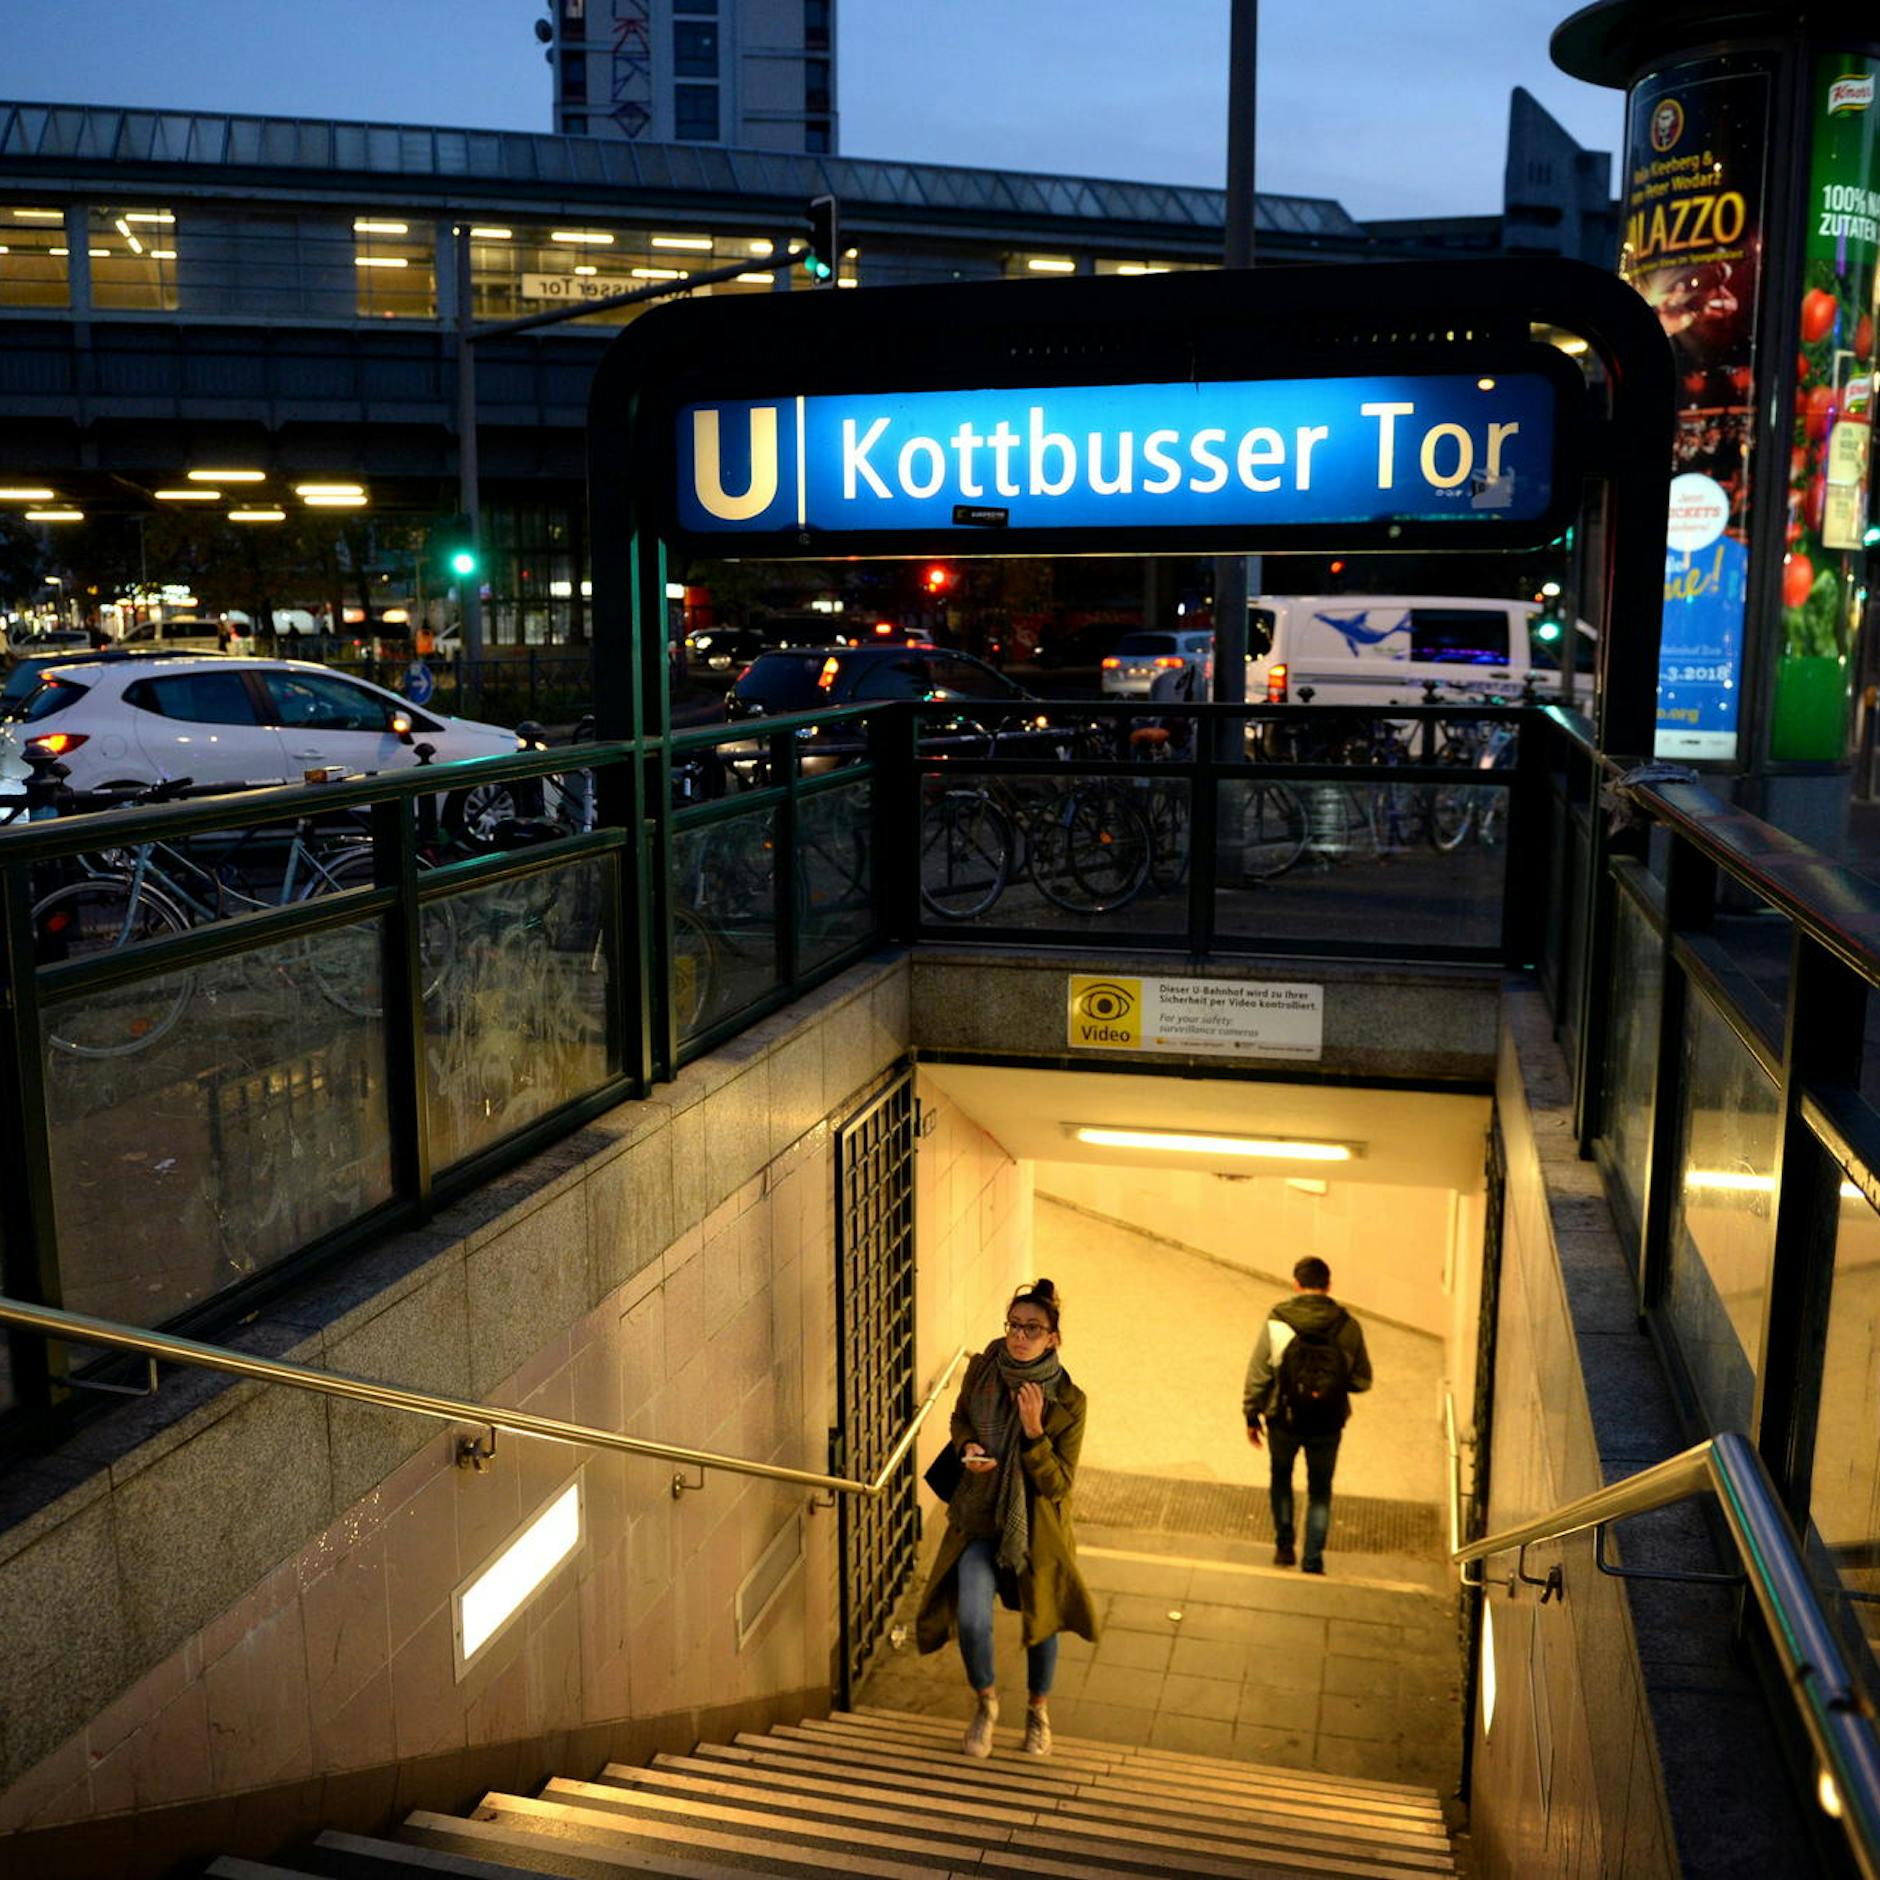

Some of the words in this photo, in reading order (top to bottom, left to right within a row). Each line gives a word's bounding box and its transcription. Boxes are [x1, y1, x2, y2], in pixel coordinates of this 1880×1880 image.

[1822, 184, 1866, 215] 100%
[694, 407, 778, 521] U
[842, 406, 1329, 500] Kottbusser
[1360, 402, 1518, 489] Tor
[1669, 505, 1722, 518] ICKETS
[1659, 665, 1729, 682] .3.2018
[1160, 984, 1189, 994] Dieser
[1247, 989, 1269, 998] wird
[1271, 990, 1282, 999] zu
[1160, 995, 1207, 1006] Sicherheit
[1210, 998, 1225, 1008] per
[1229, 998, 1257, 1008] Video
[1081, 1025, 1130, 1042] Video
